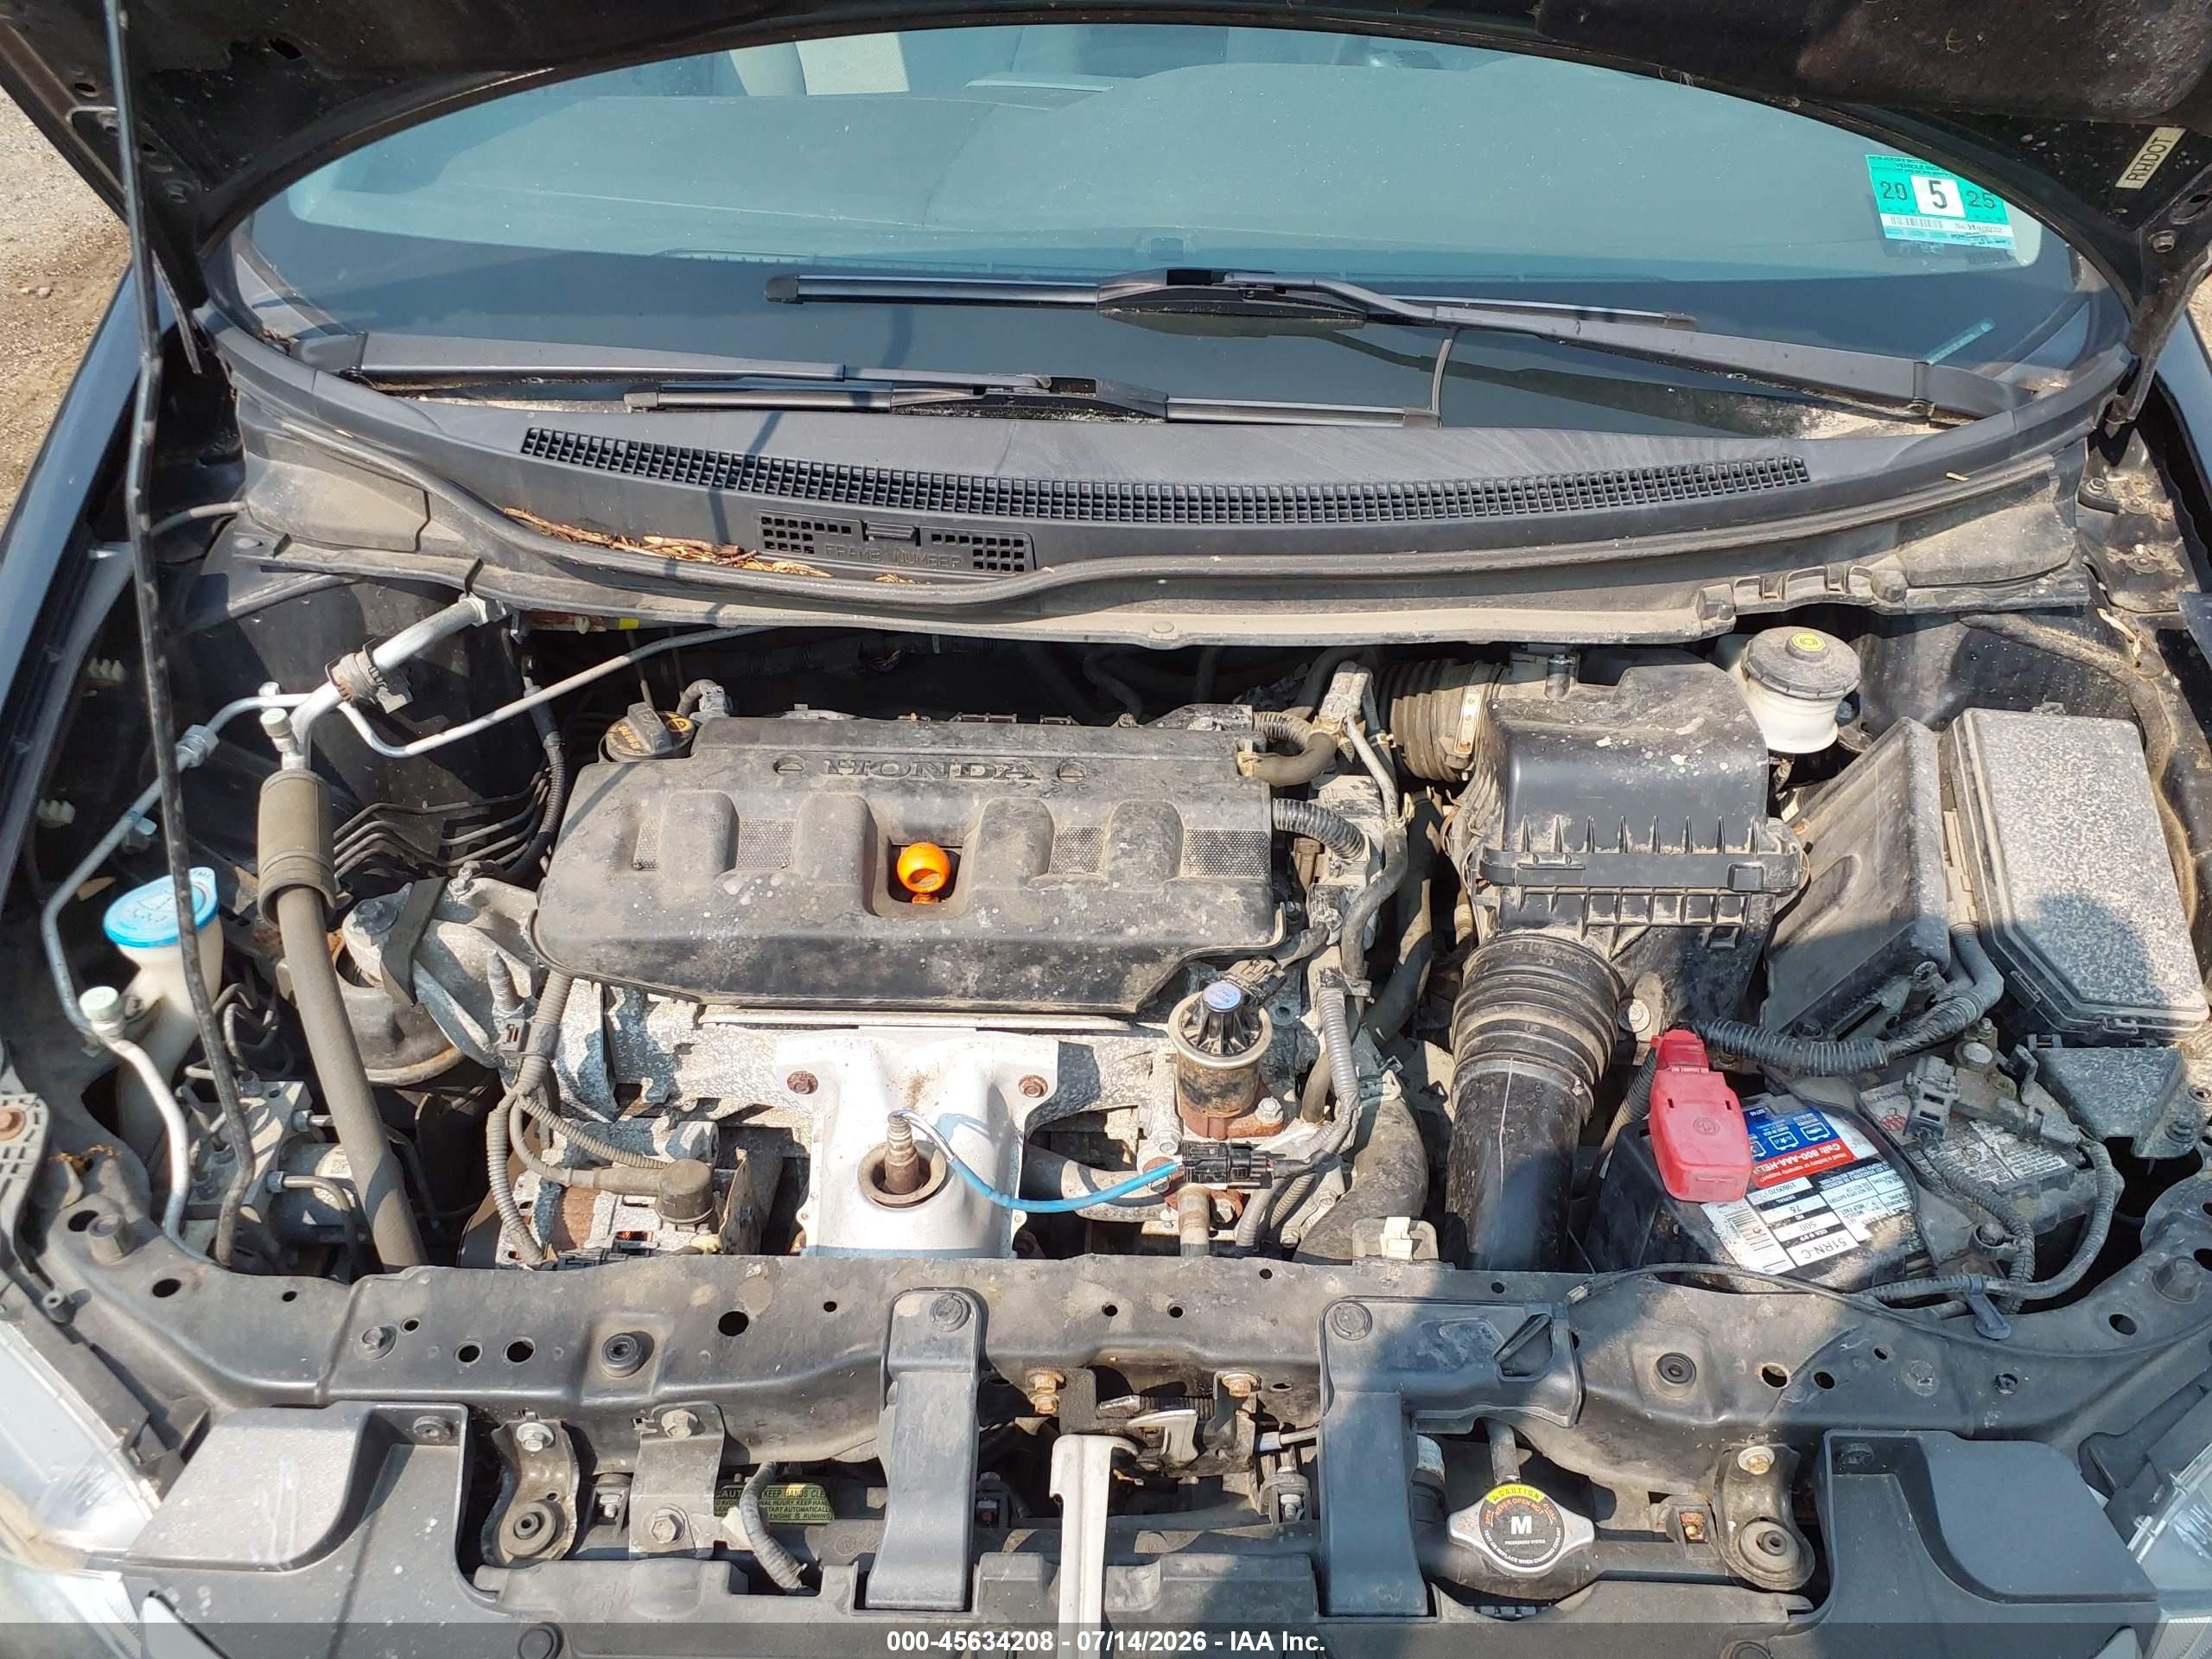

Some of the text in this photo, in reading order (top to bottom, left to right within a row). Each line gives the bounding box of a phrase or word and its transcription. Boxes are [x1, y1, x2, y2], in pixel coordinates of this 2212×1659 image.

[1880, 180, 1995, 209] 20 5 25
[825, 544, 962, 568] FRAME NUMBER
[822, 760, 1040, 779] HONDA
[1819, 1143, 1840, 1154] Call:
[1776, 1195, 1796, 1204] SERIAL
[1790, 1205, 1802, 1213] 75
[1799, 1221, 1816, 1231] 500
[1801, 1237, 1847, 1259] 51RN-C
[716, 1489, 826, 1498] CAUT KEEP HANDS CLE
[1498, 1488, 1541, 1499] CAUTION
[1495, 1497, 1544, 1516] NEVER OPEN HOT
[1510, 1516, 1532, 1535] M
[1497, 1548, 1518, 1562] REPLACE
